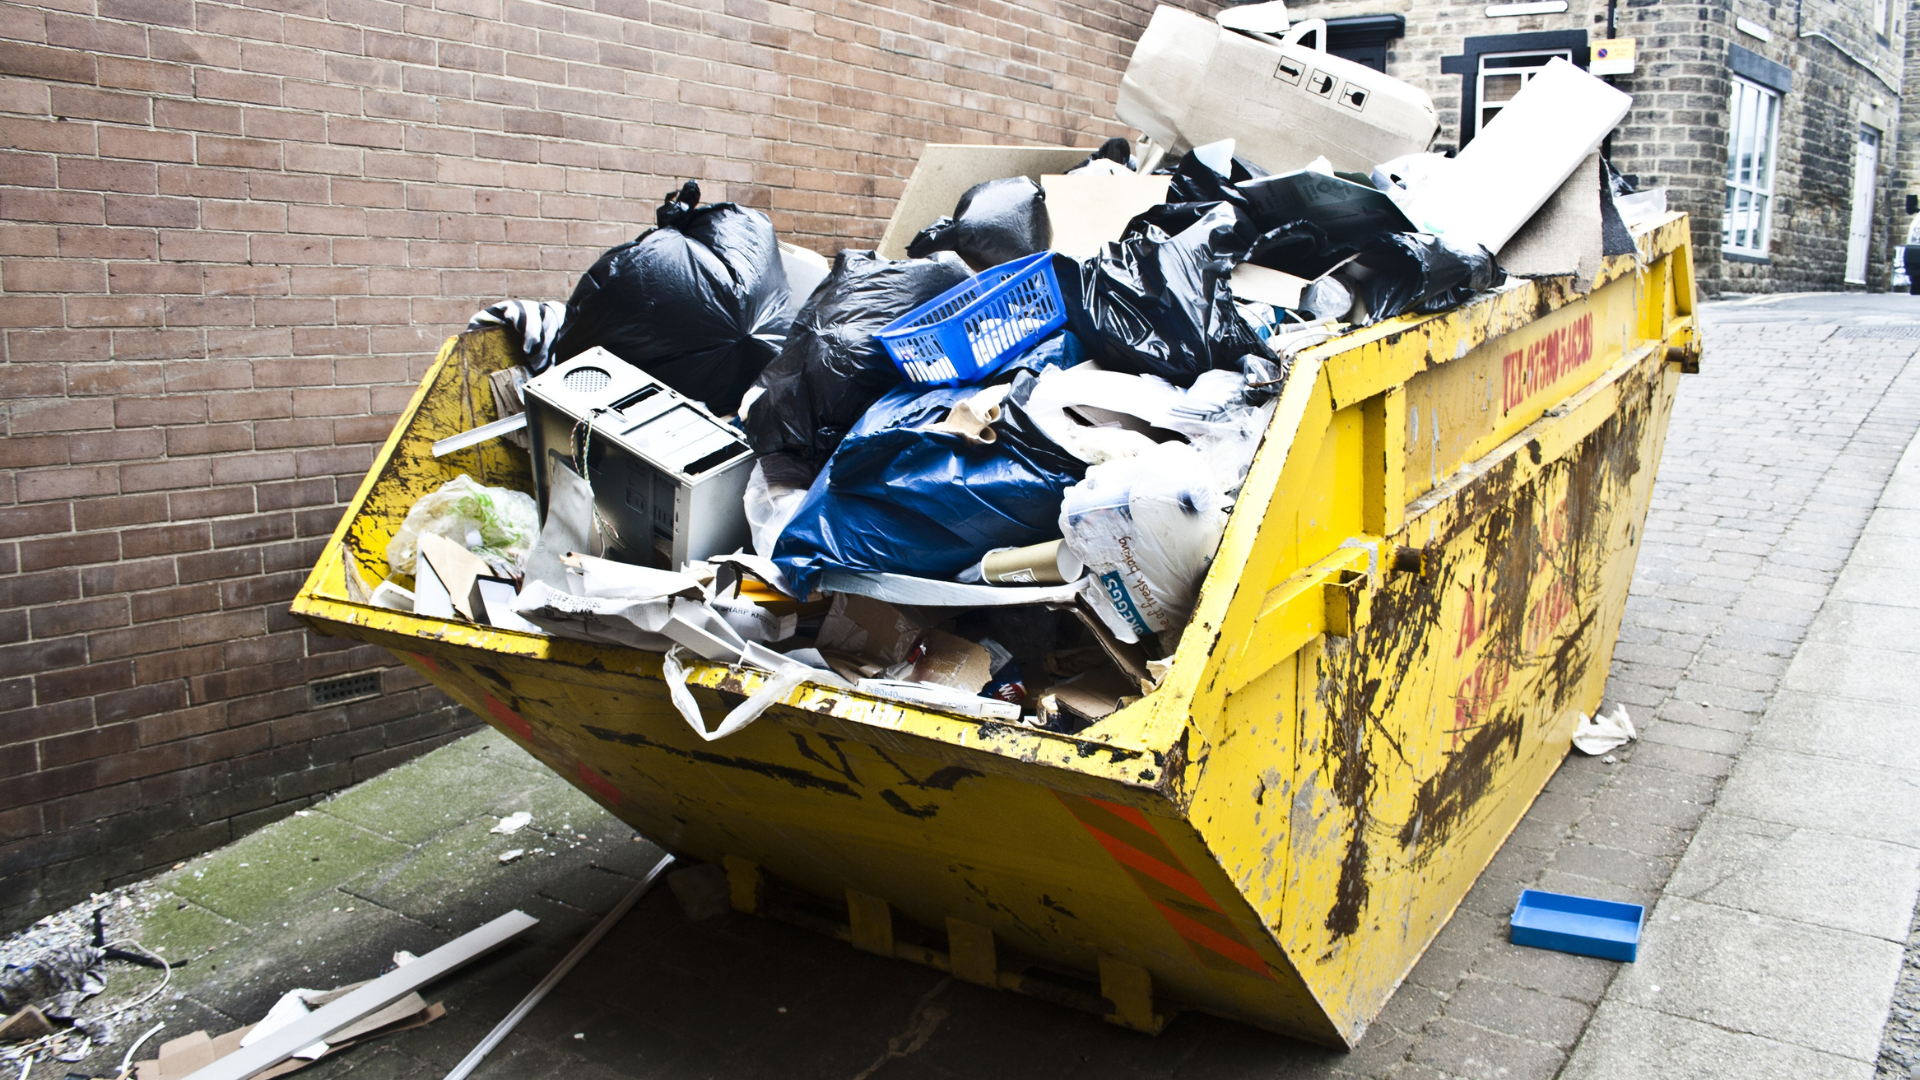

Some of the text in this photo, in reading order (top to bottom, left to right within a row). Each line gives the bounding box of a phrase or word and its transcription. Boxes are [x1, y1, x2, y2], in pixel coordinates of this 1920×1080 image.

[1503, 349, 1523, 414] TEL
[1118, 536, 1141, 577] baking
[1133, 575, 1158, 609] fresh
